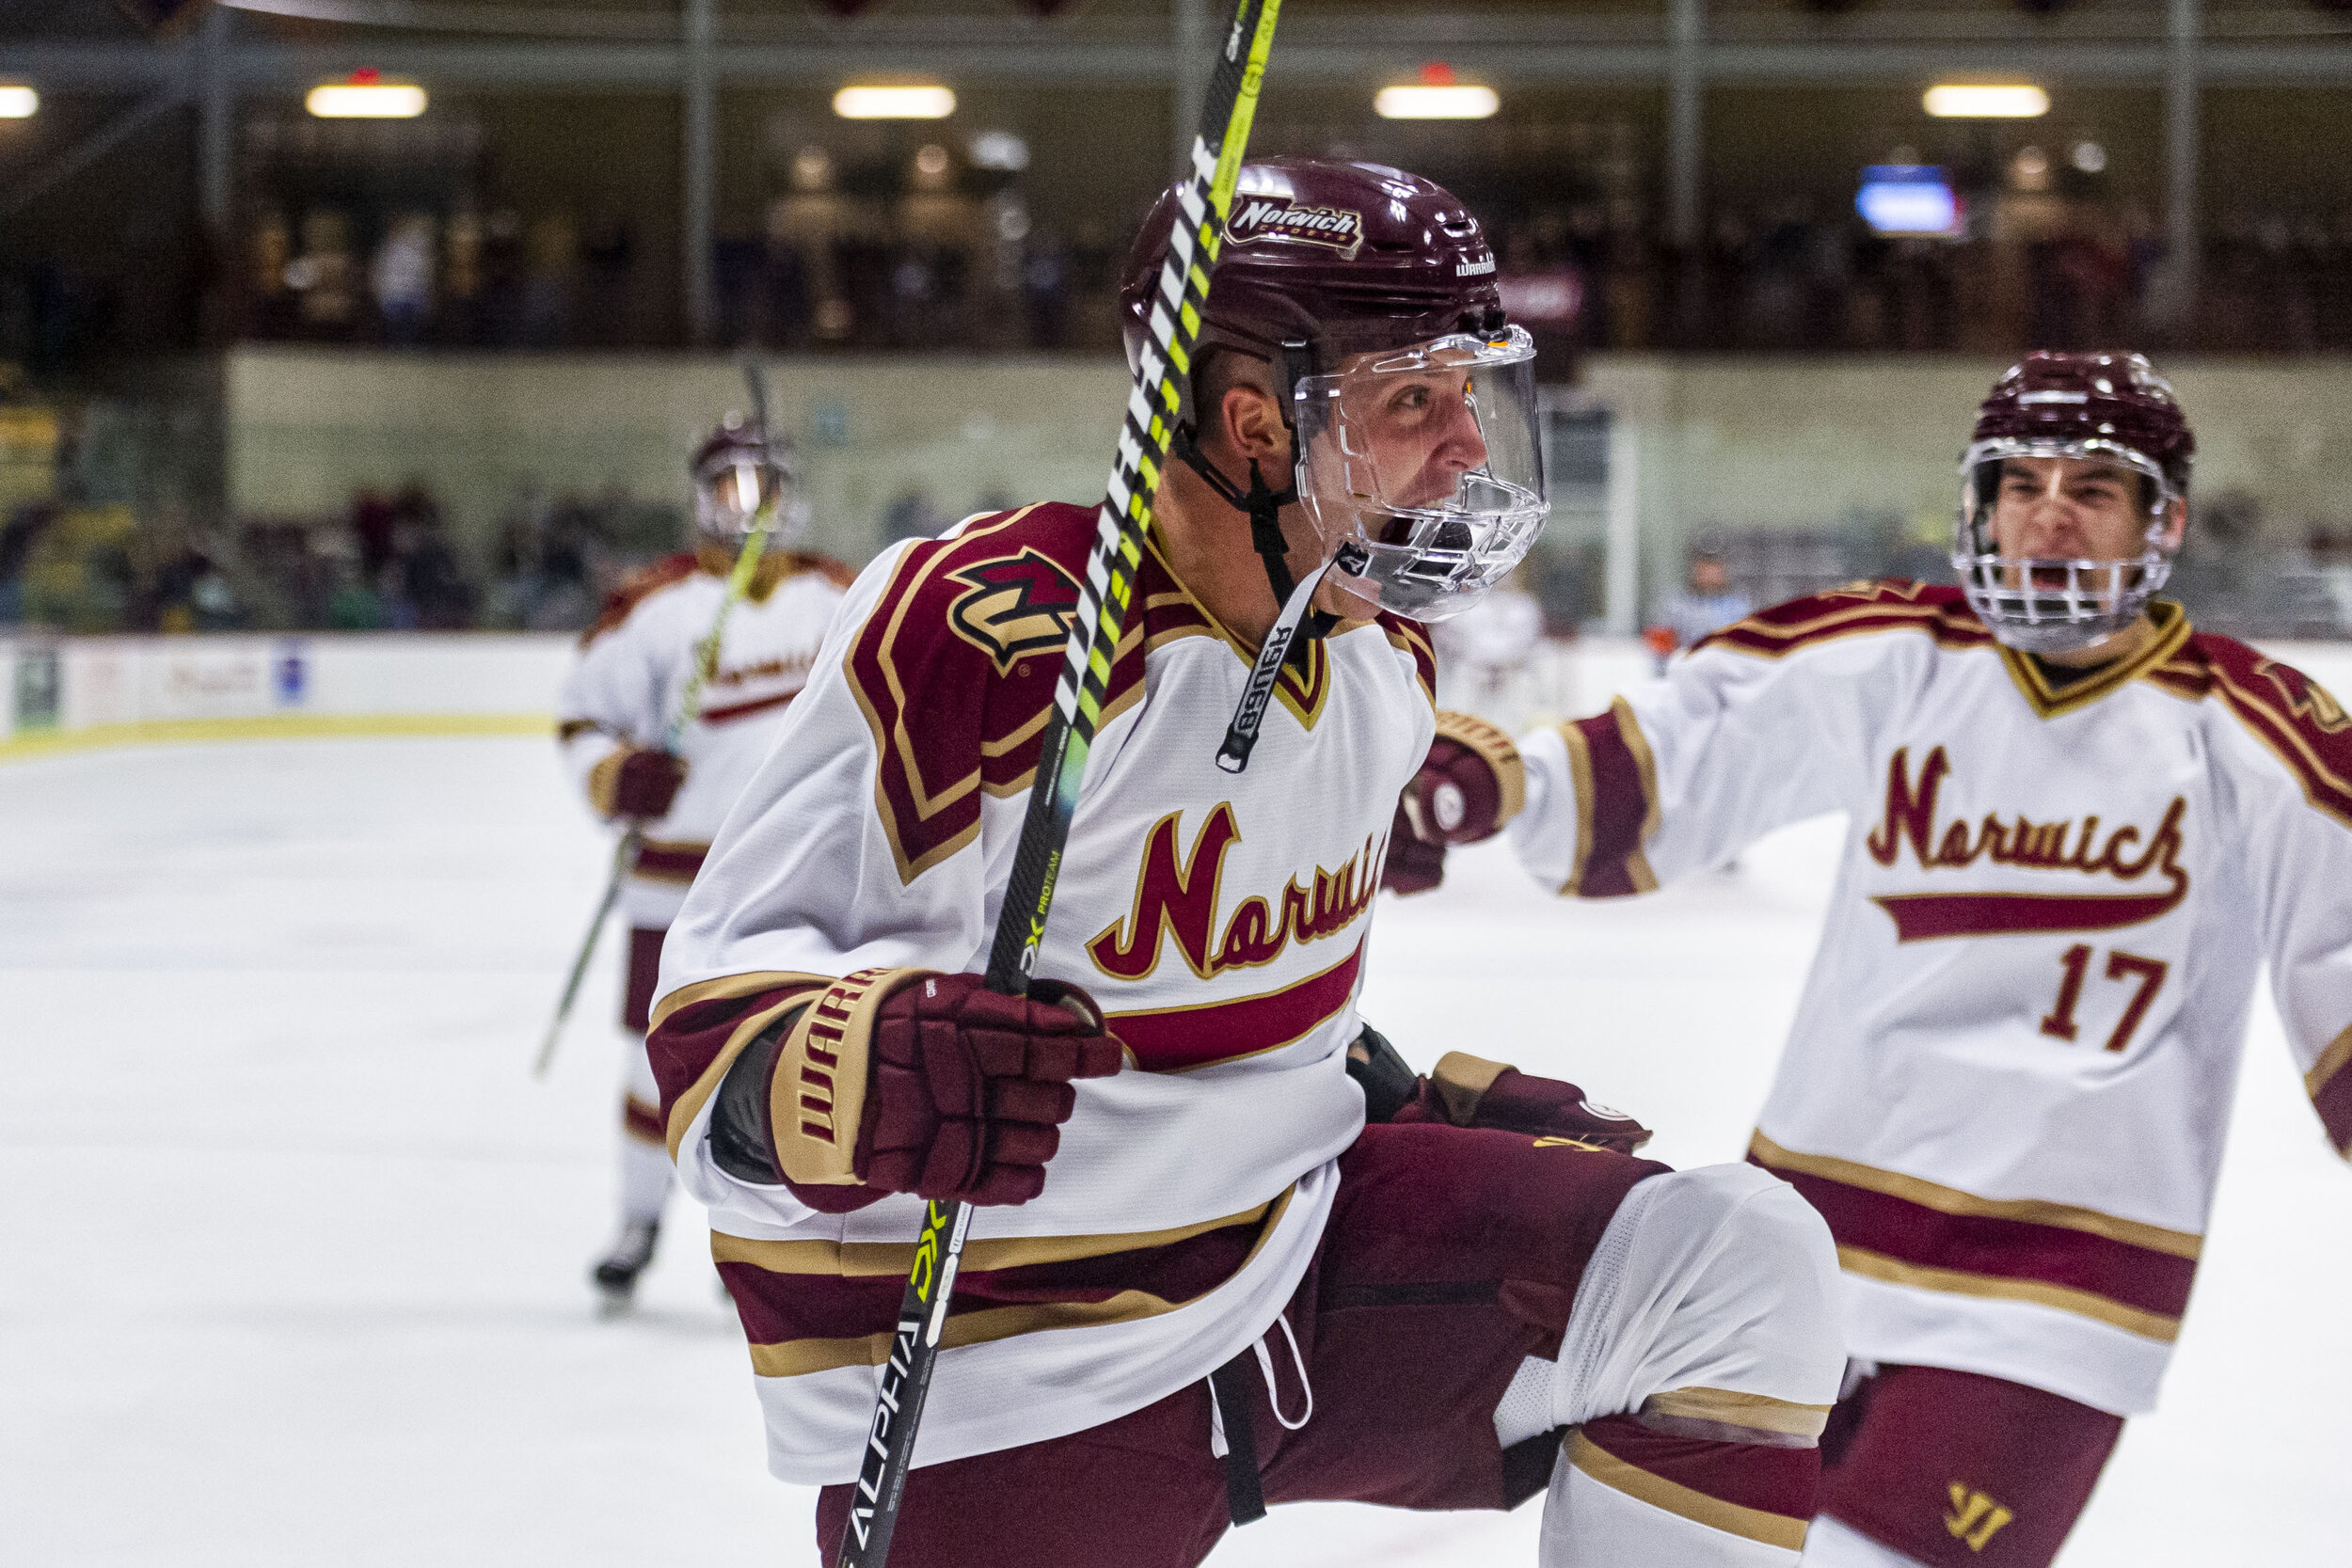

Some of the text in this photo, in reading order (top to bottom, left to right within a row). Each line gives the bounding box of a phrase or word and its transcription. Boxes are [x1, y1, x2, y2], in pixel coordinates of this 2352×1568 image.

[1233, 201, 1356, 234] Norwich
[1259, 224, 1348, 243] CADETS
[1866, 744, 2190, 882] Norwich
[800, 967, 890, 1145] WARR
[2038, 942, 2170, 1053] 17
[850, 1321, 921, 1552] ALPHA
